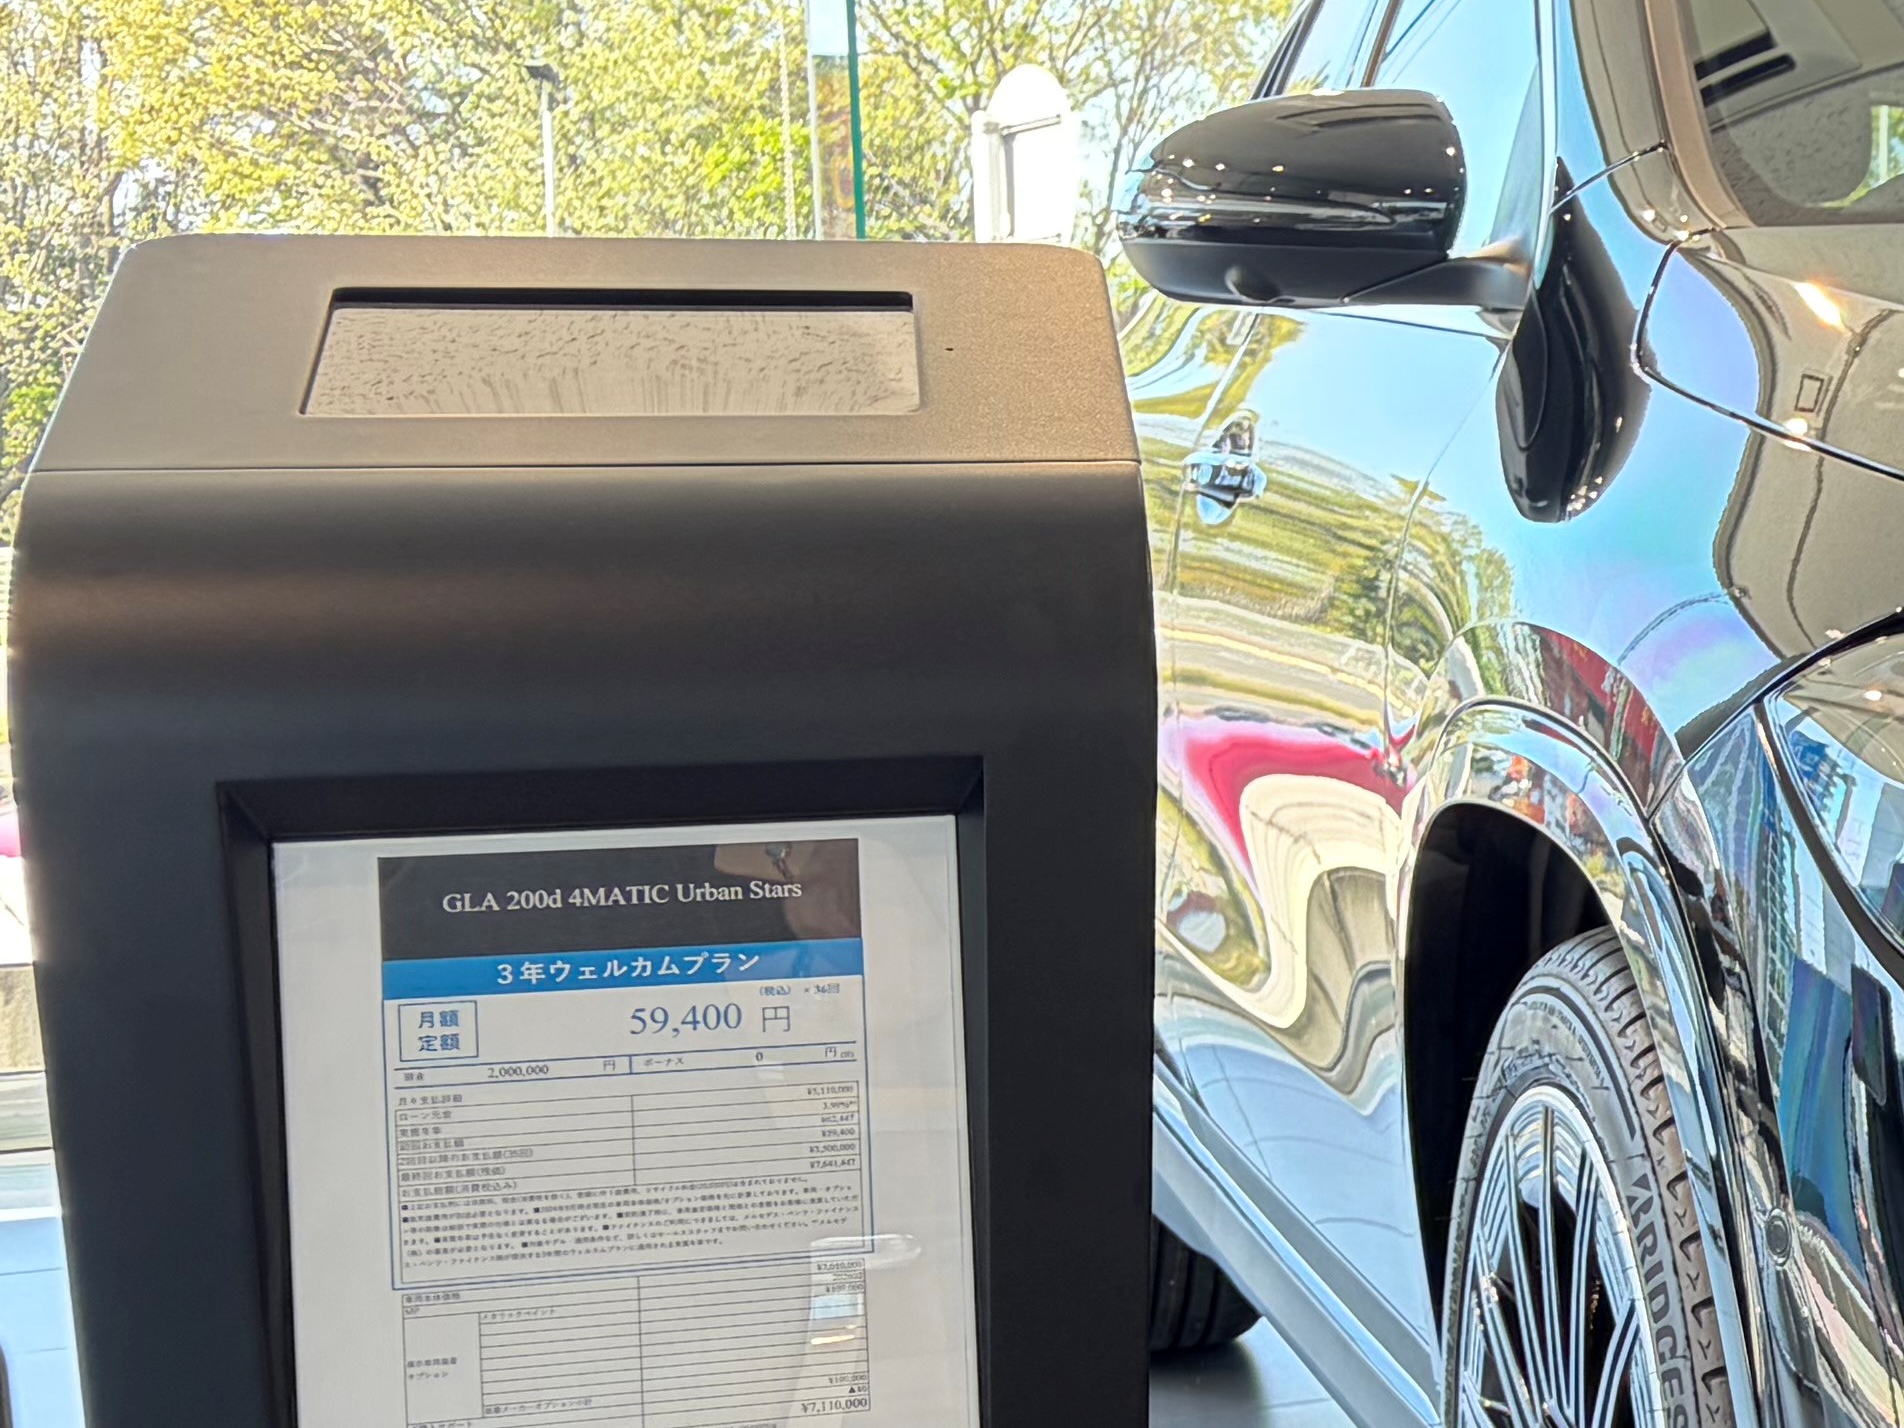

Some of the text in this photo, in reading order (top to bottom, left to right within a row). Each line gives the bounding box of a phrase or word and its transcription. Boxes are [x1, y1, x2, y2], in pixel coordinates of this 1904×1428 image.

[443, 881, 802, 914] GLA 200d 4MATIC Urban Stars
[418, 1010, 459, 1029] 月額
[630, 1003, 790, 1038] 59,400 円
[418, 1034, 461, 1052] 定額
[487, 1064, 549, 1079] 2,000,000
